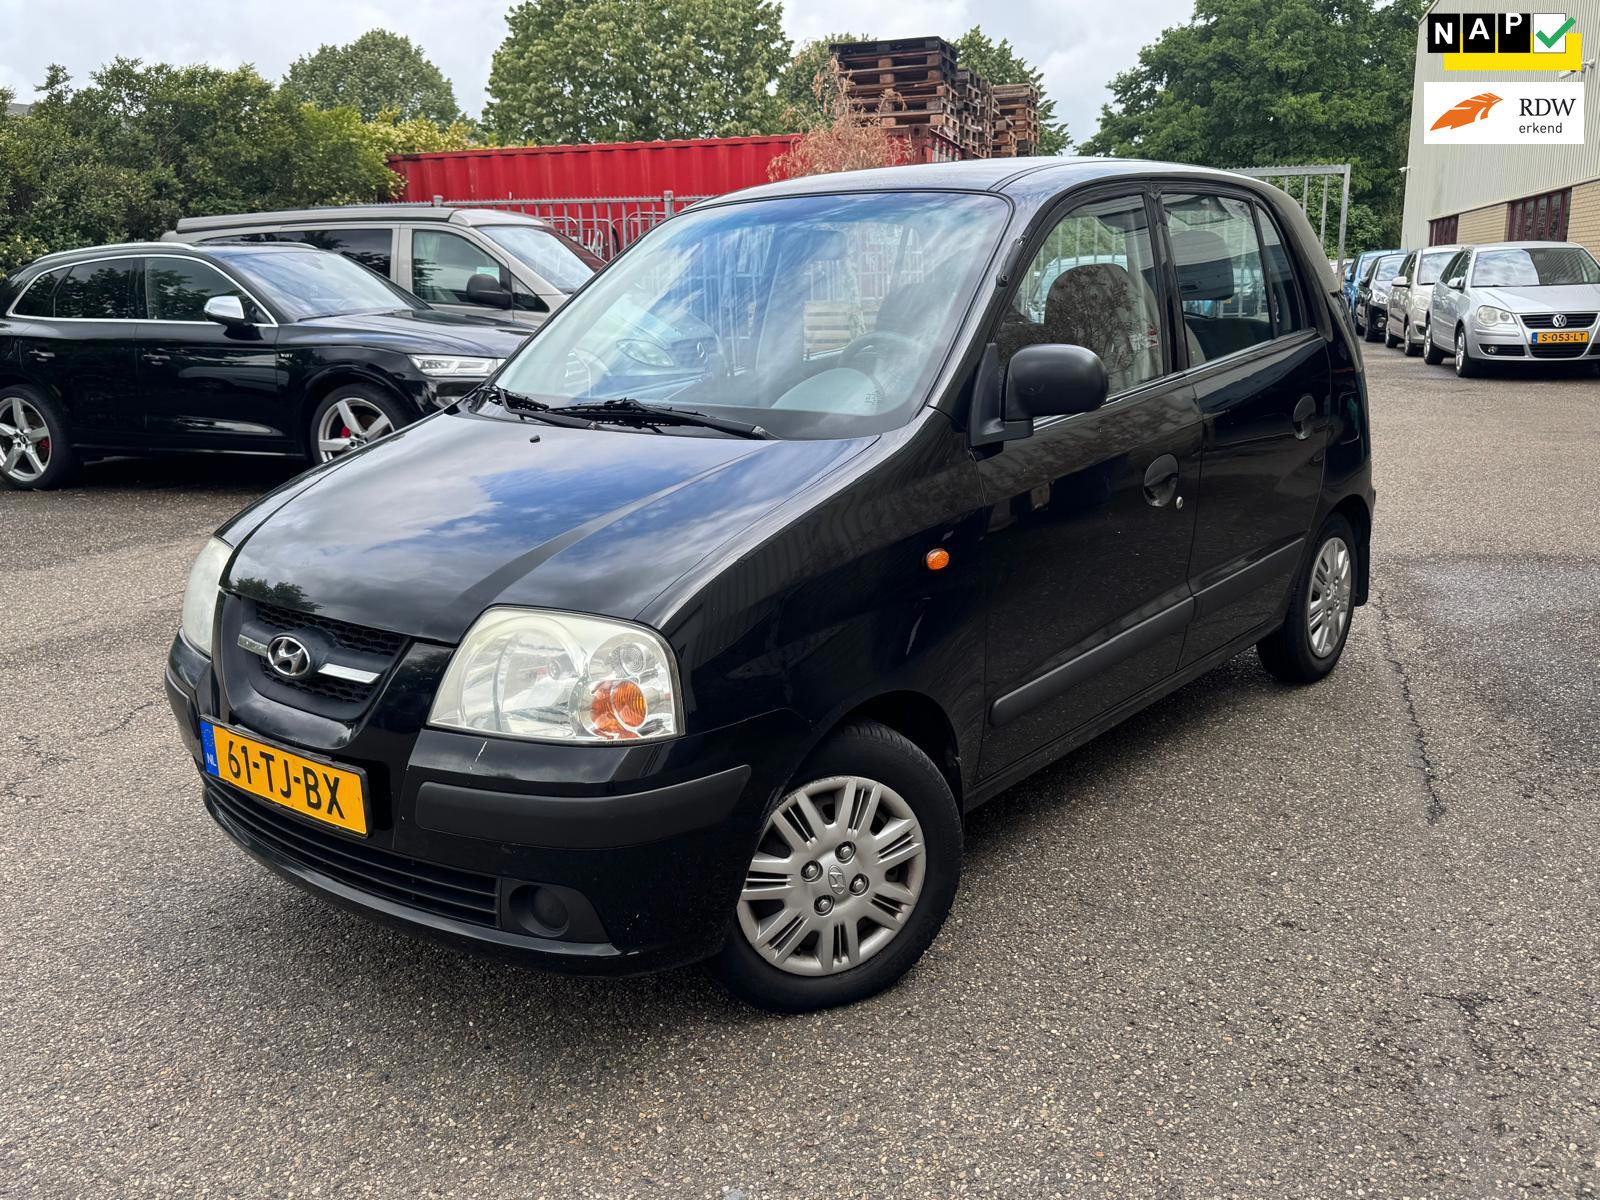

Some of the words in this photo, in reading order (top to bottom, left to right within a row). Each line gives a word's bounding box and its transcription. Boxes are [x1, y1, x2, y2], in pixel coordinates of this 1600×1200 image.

[1541, 333, 1585, 342] S-053-LT
[206, 752, 217, 767] NL
[228, 740, 346, 820] 61-TJ-BX
